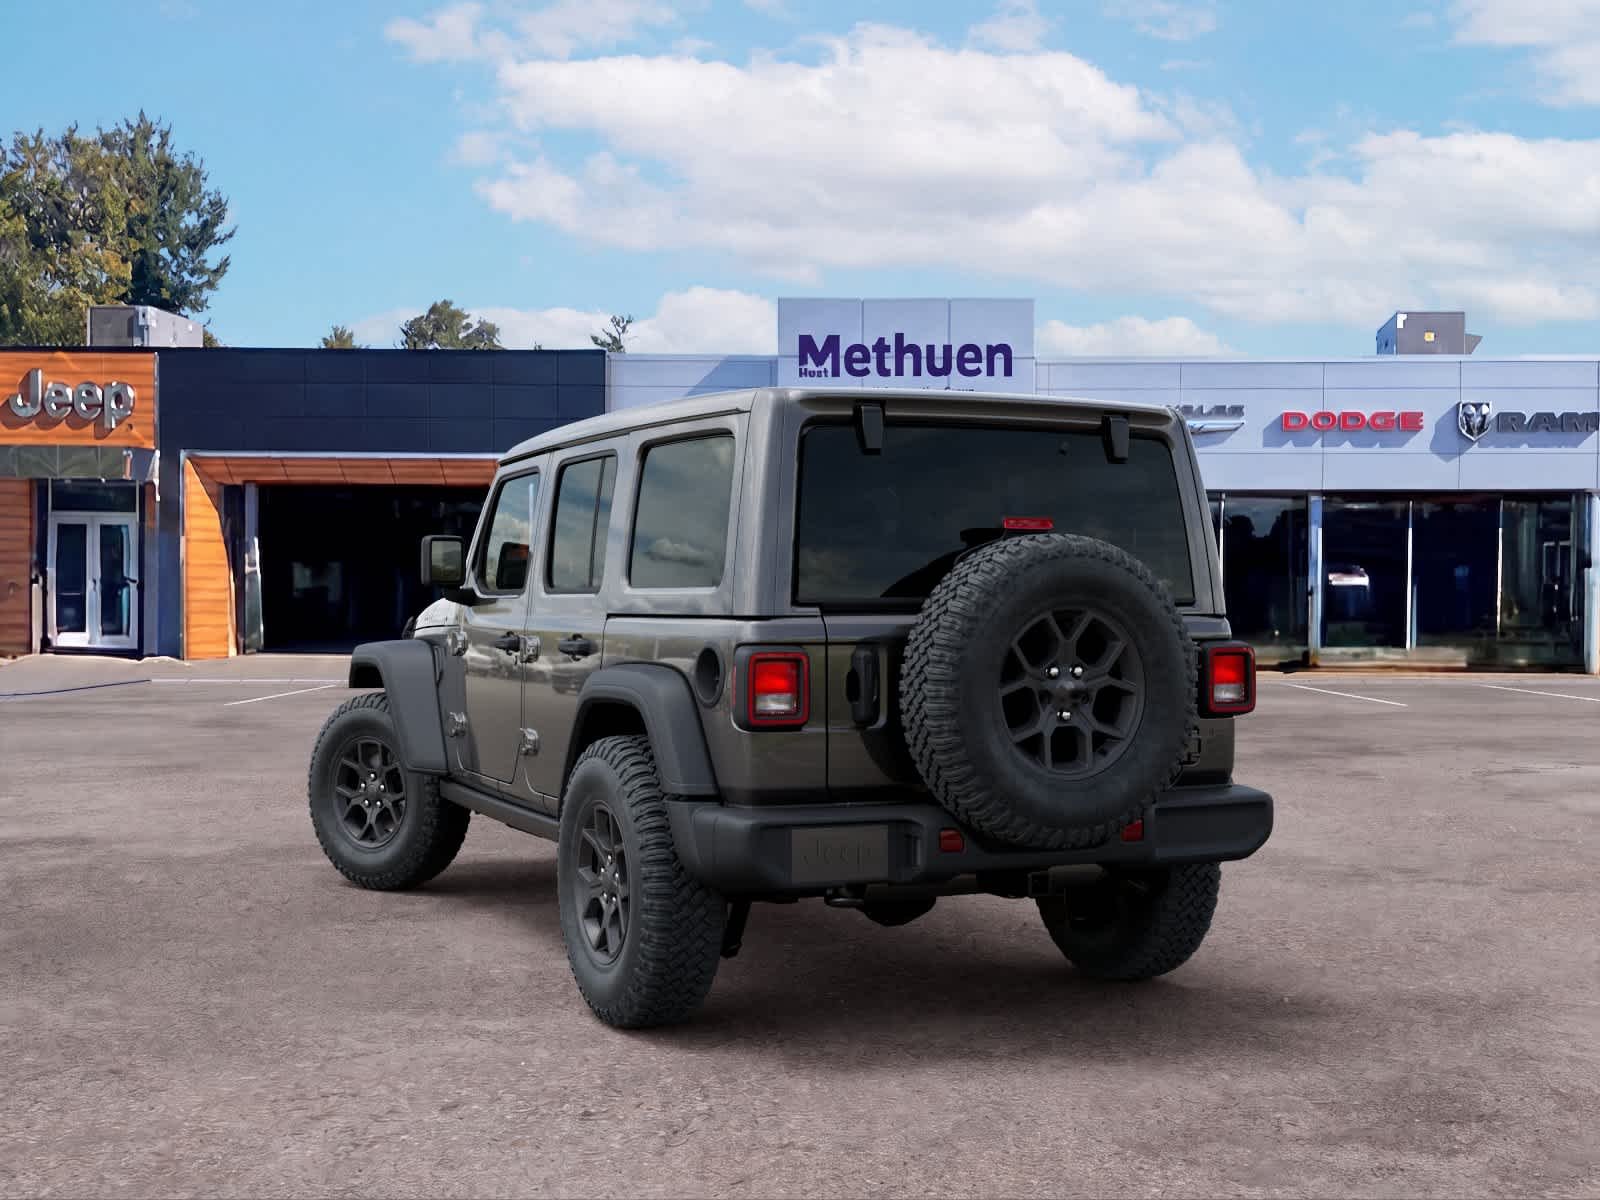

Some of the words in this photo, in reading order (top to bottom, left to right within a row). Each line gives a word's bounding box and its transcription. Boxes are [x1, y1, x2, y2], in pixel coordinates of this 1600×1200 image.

[798, 333, 1013, 377] Methuen
[8, 367, 136, 428] Jeep
[1281, 411, 1424, 432] DODGE
[1498, 412, 1600, 433] RAM
